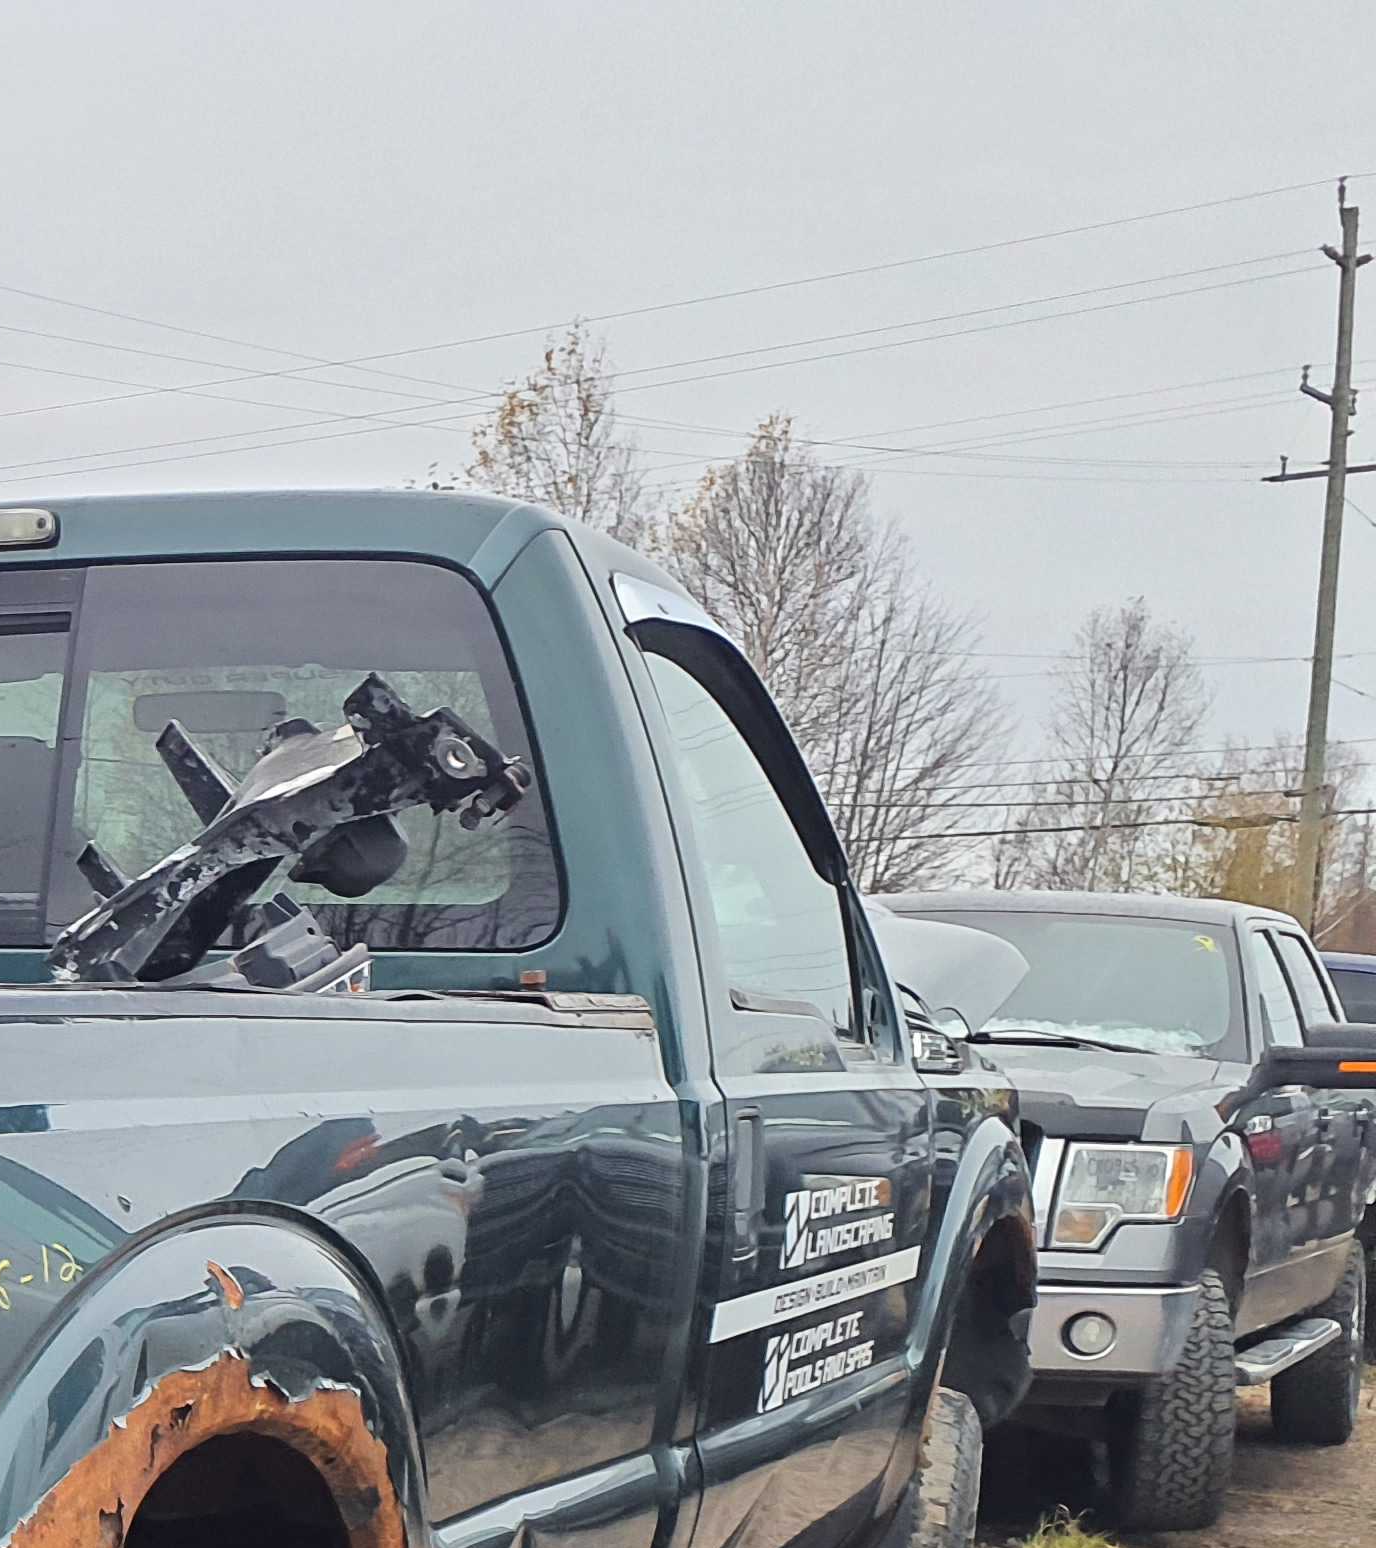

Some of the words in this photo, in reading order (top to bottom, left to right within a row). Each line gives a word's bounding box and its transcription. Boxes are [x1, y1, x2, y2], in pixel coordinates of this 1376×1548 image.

[809, 1180, 880, 1219] COMPLETE
[805, 1212, 895, 1260] LANDSCAPING
[789, 1310, 864, 1360] COMPLETE
[783, 1359, 825, 1400] POOLS
